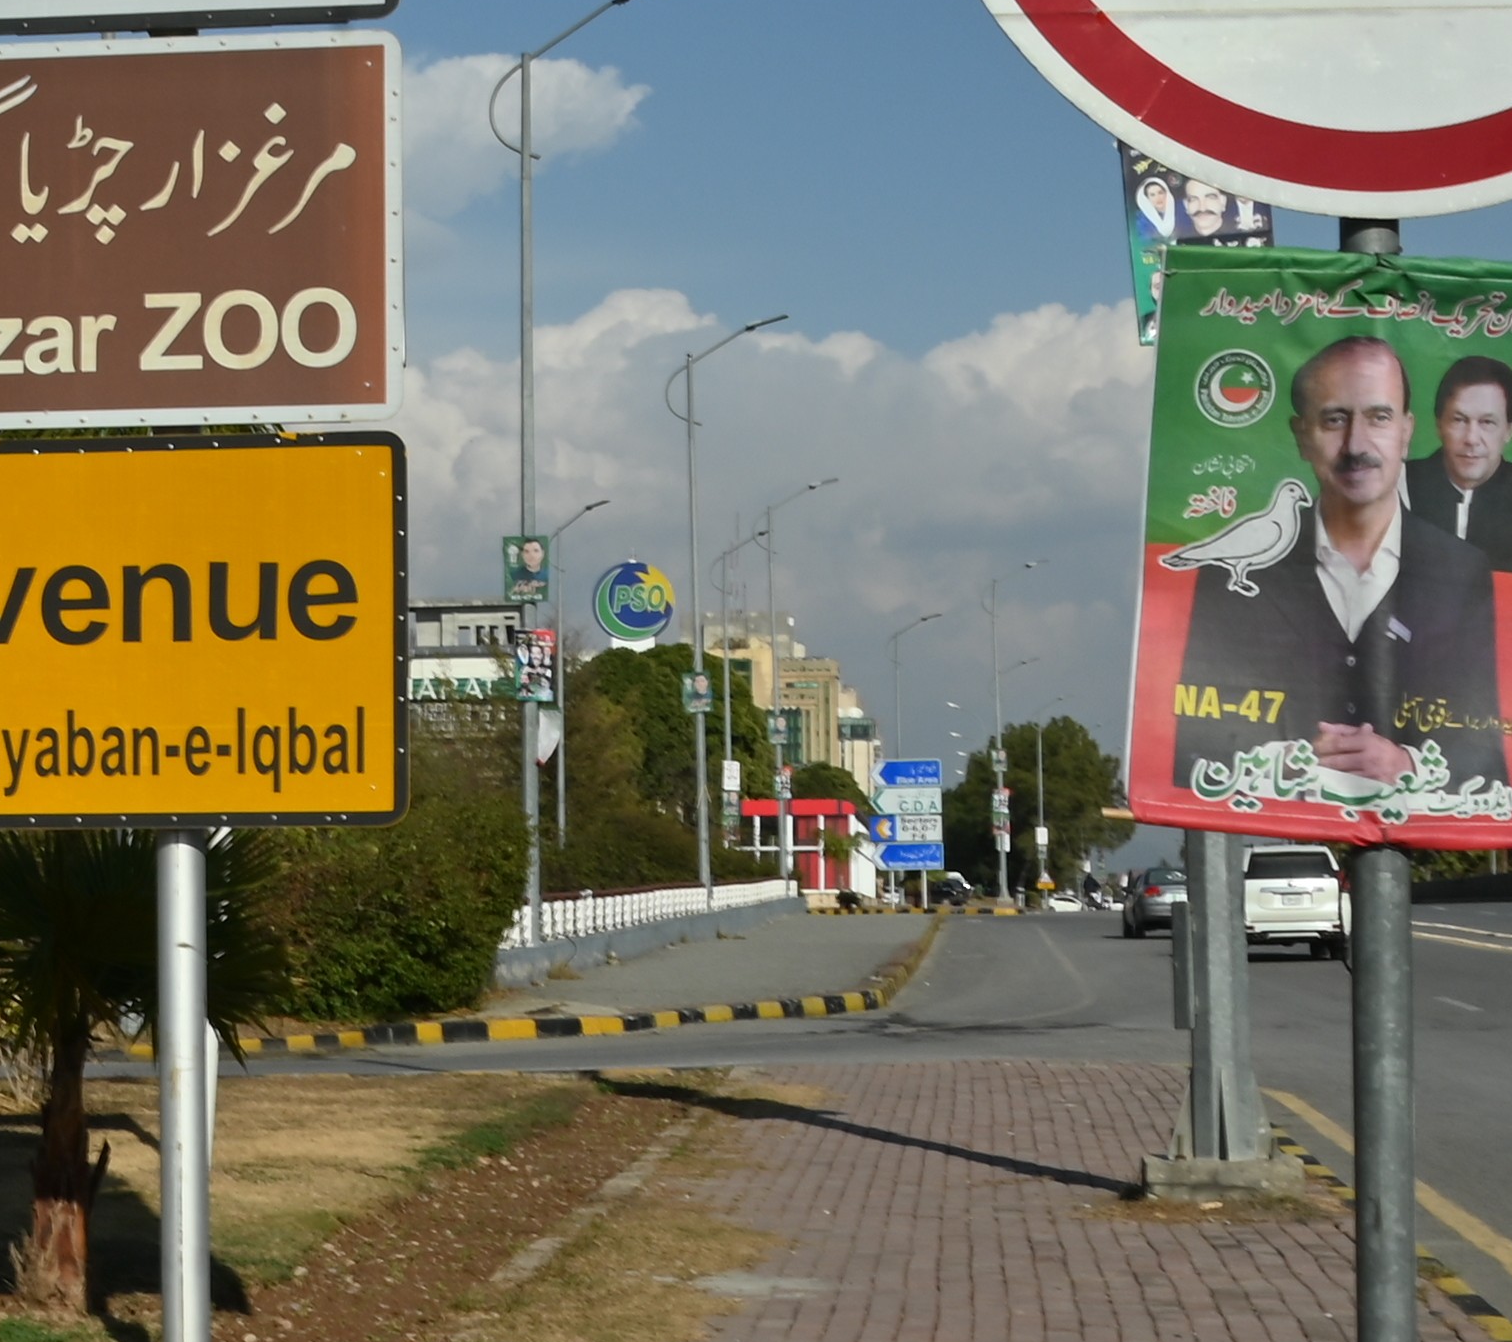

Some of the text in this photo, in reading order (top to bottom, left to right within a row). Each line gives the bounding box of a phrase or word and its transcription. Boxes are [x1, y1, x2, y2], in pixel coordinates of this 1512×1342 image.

[10, 115, 134, 245] چڑیا
[139, 102, 357, 237] مرغزار
[1200, 286, 1282, 324] امیدوار
[1326, 279, 1364, 319] کے
[1367, 291, 1434, 322] انصاف
[1432, 290, 1506, 339] تحریک
[139, 287, 357, 371] ZOO
[1182, 485, 1237, 519] فاختہ
[613, 583, 665, 614] PSO
[1174, 683, 1286, 724] NA-47
[1418, 698, 1447, 734] قومی
[1190, 738, 1320, 813] شاہین
[1320, 738, 1450, 823] شعیب
